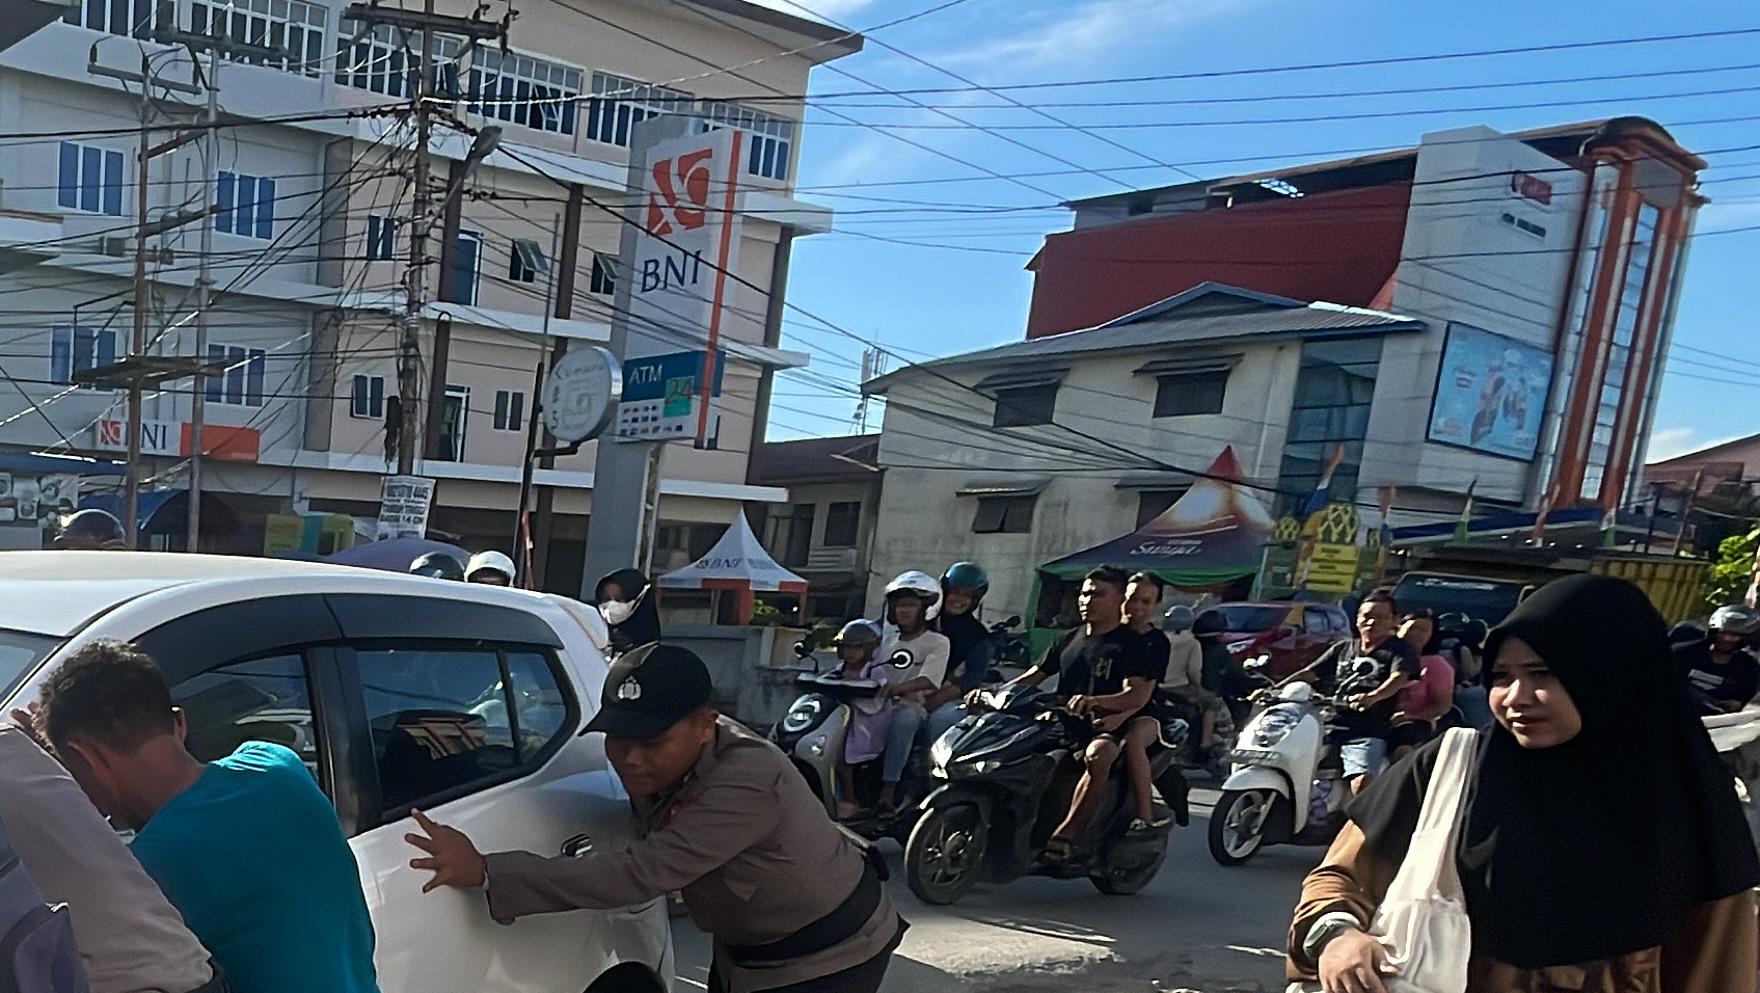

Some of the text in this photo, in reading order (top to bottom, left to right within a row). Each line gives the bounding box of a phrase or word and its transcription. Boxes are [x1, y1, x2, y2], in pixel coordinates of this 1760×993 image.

[640, 249, 702, 293] BNI
[628, 364, 663, 385] ATM
[125, 421, 167, 450] NI
